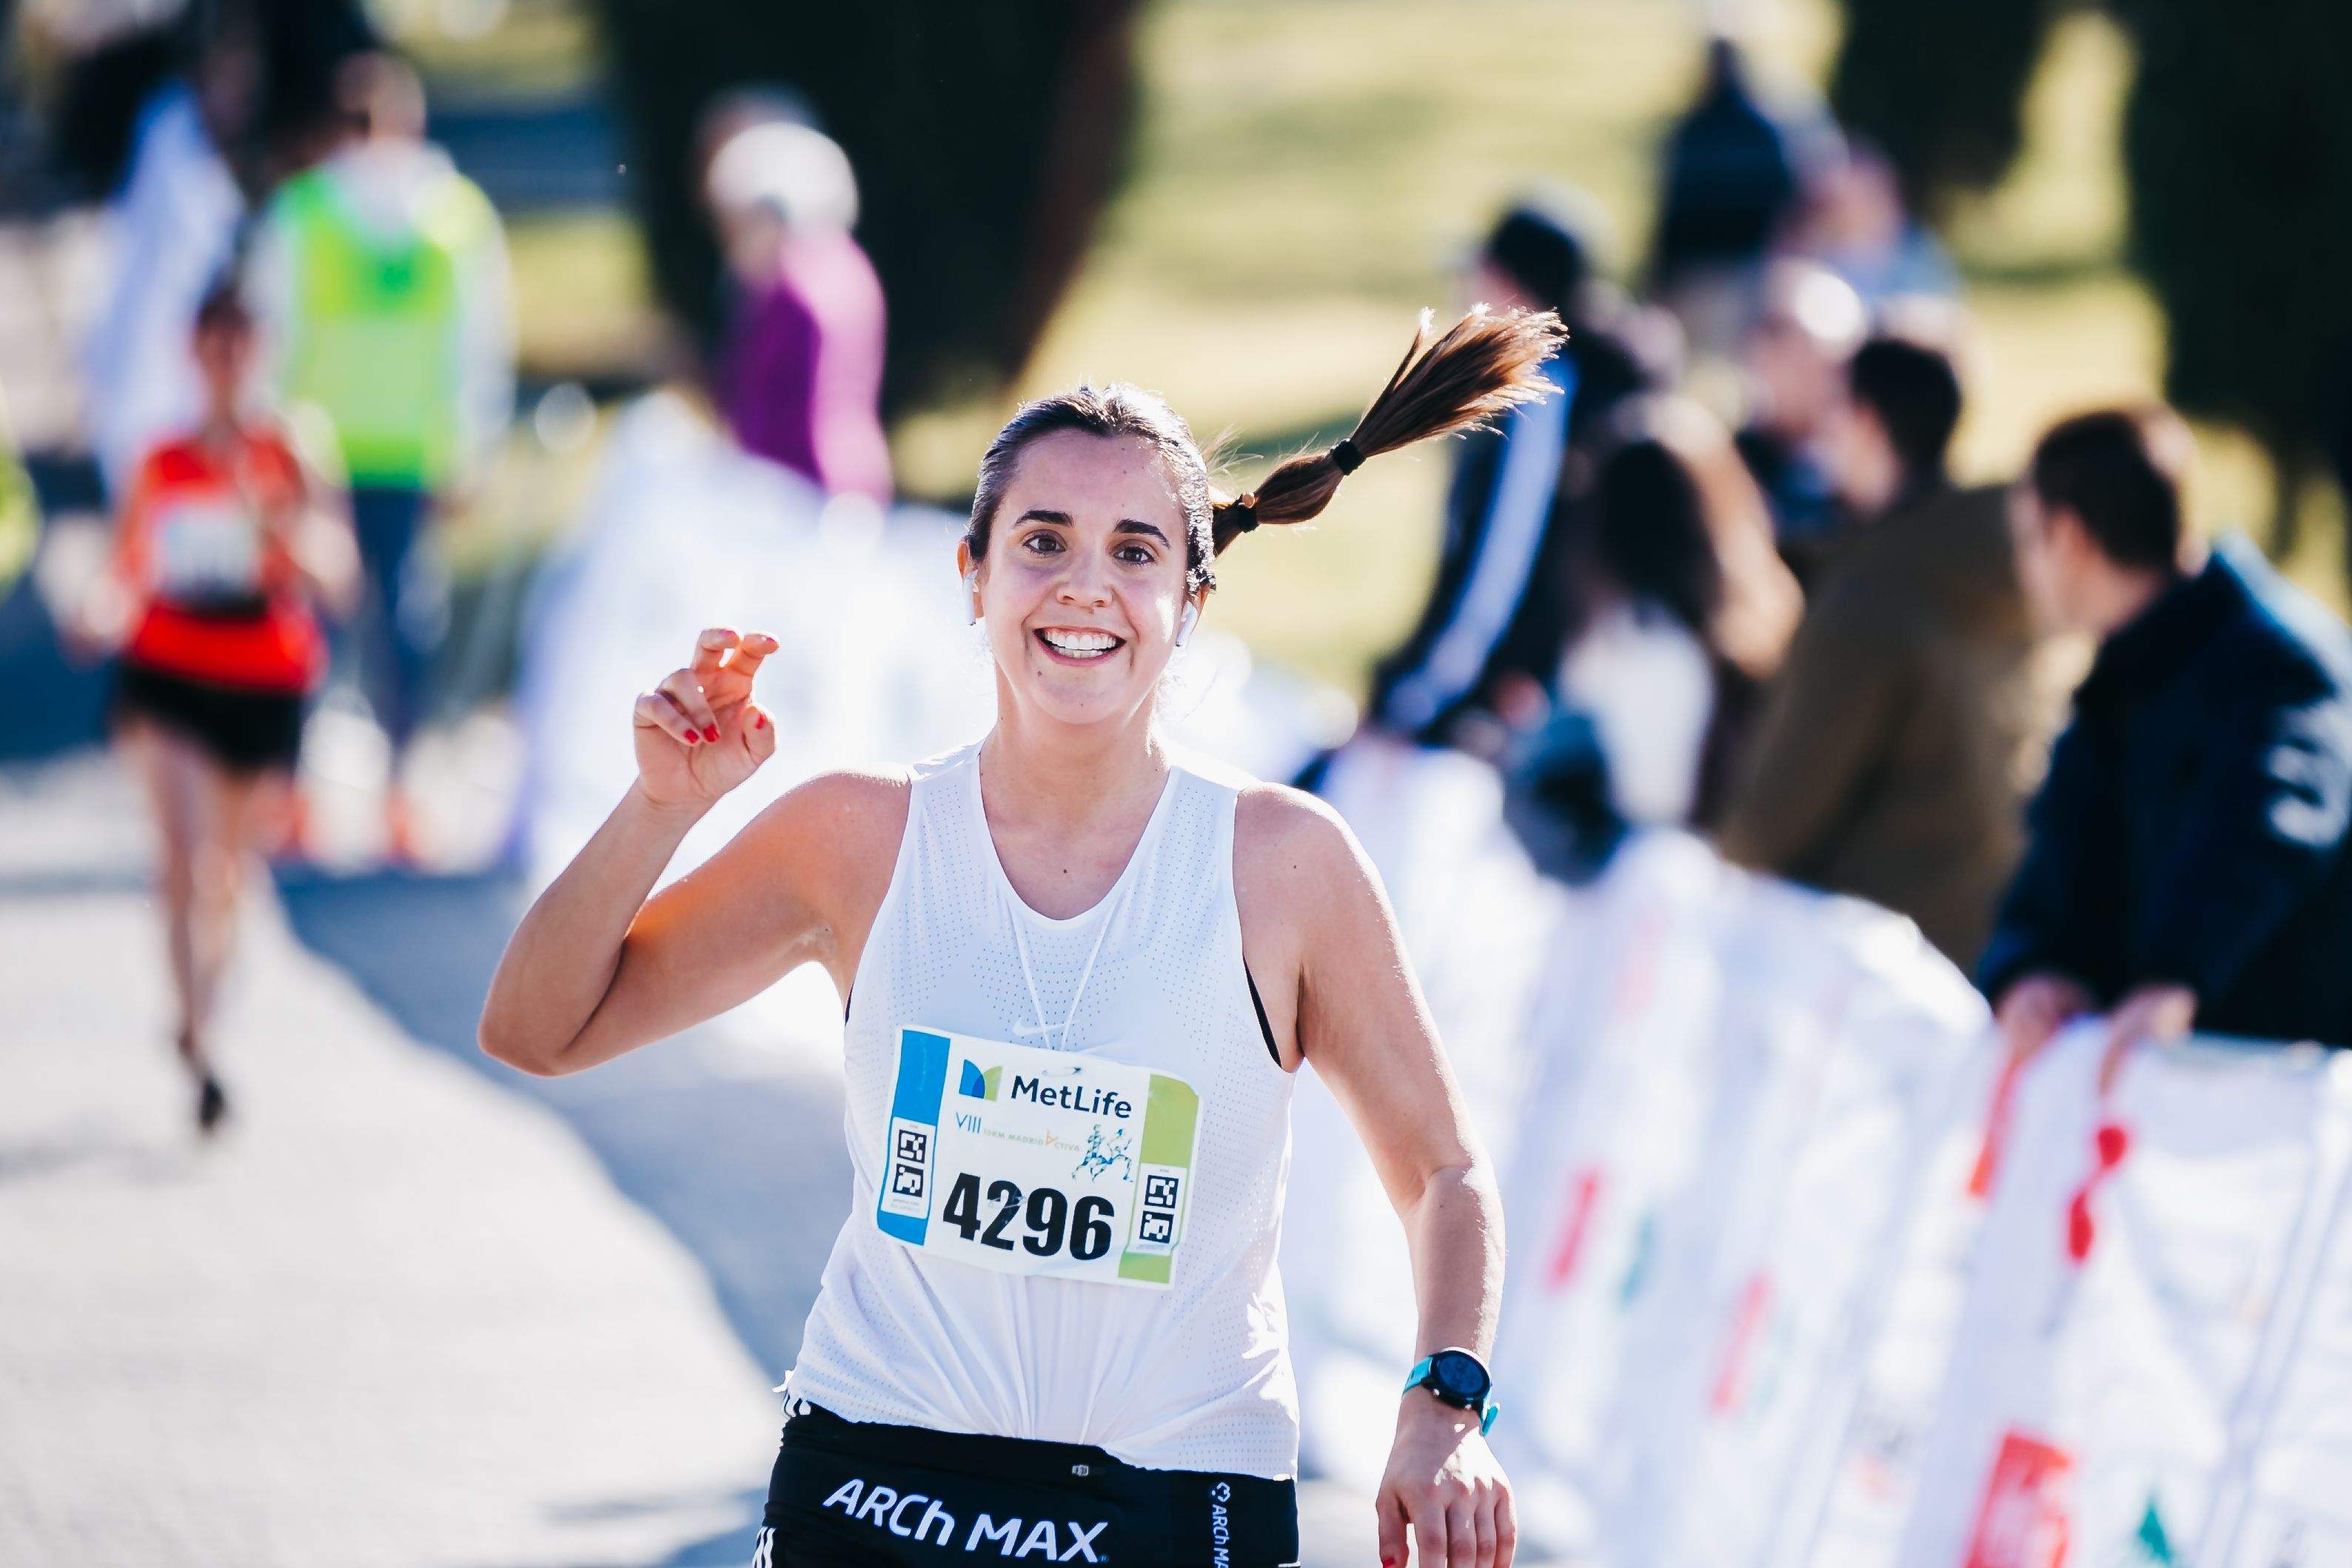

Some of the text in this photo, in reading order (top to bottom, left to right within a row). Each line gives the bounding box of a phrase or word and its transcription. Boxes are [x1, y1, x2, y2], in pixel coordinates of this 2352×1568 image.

[1011, 1076, 1131, 1118] MetLife
[956, 1112, 982, 1133] VIII
[1008, 1133, 1043, 1145] MADRID
[943, 1173, 1114, 1260] 4296
[965, 1514, 1108, 1563] MAX
